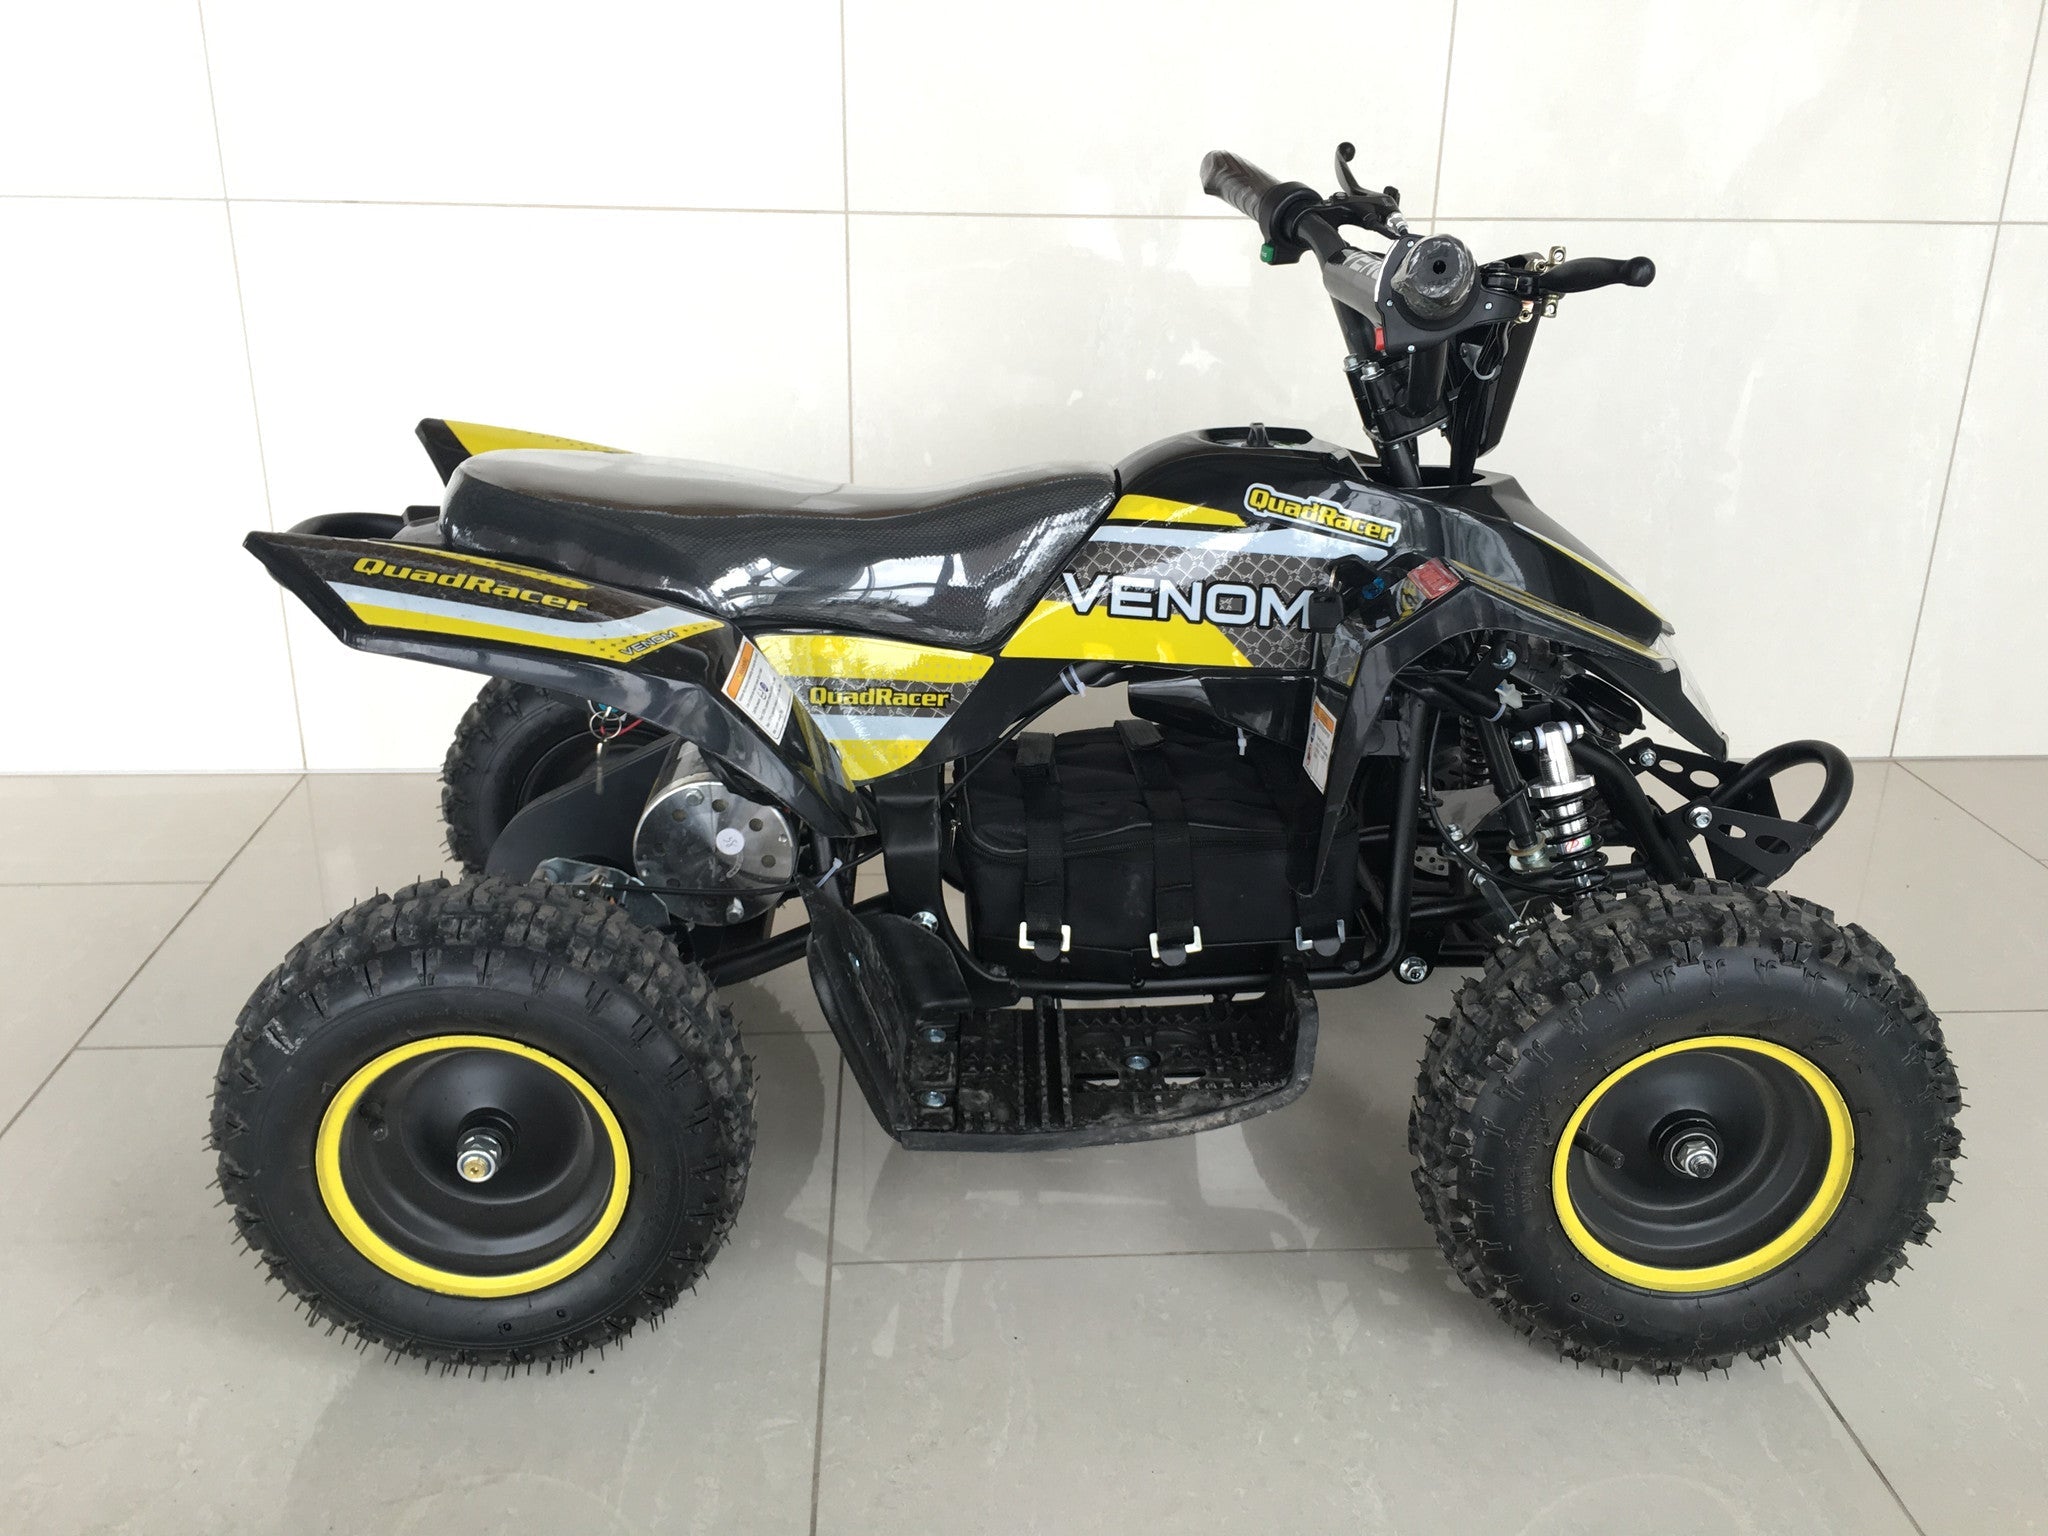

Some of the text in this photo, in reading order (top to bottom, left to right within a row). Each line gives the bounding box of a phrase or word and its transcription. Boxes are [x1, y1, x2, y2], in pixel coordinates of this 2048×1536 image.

[1249, 488, 1395, 543] QuadRacer
[354, 557, 590, 613] QuadRacer
[1062, 571, 1312, 629] VENOM
[619, 630, 677, 657] VENOM
[809, 686, 950, 708] QuadRacer
